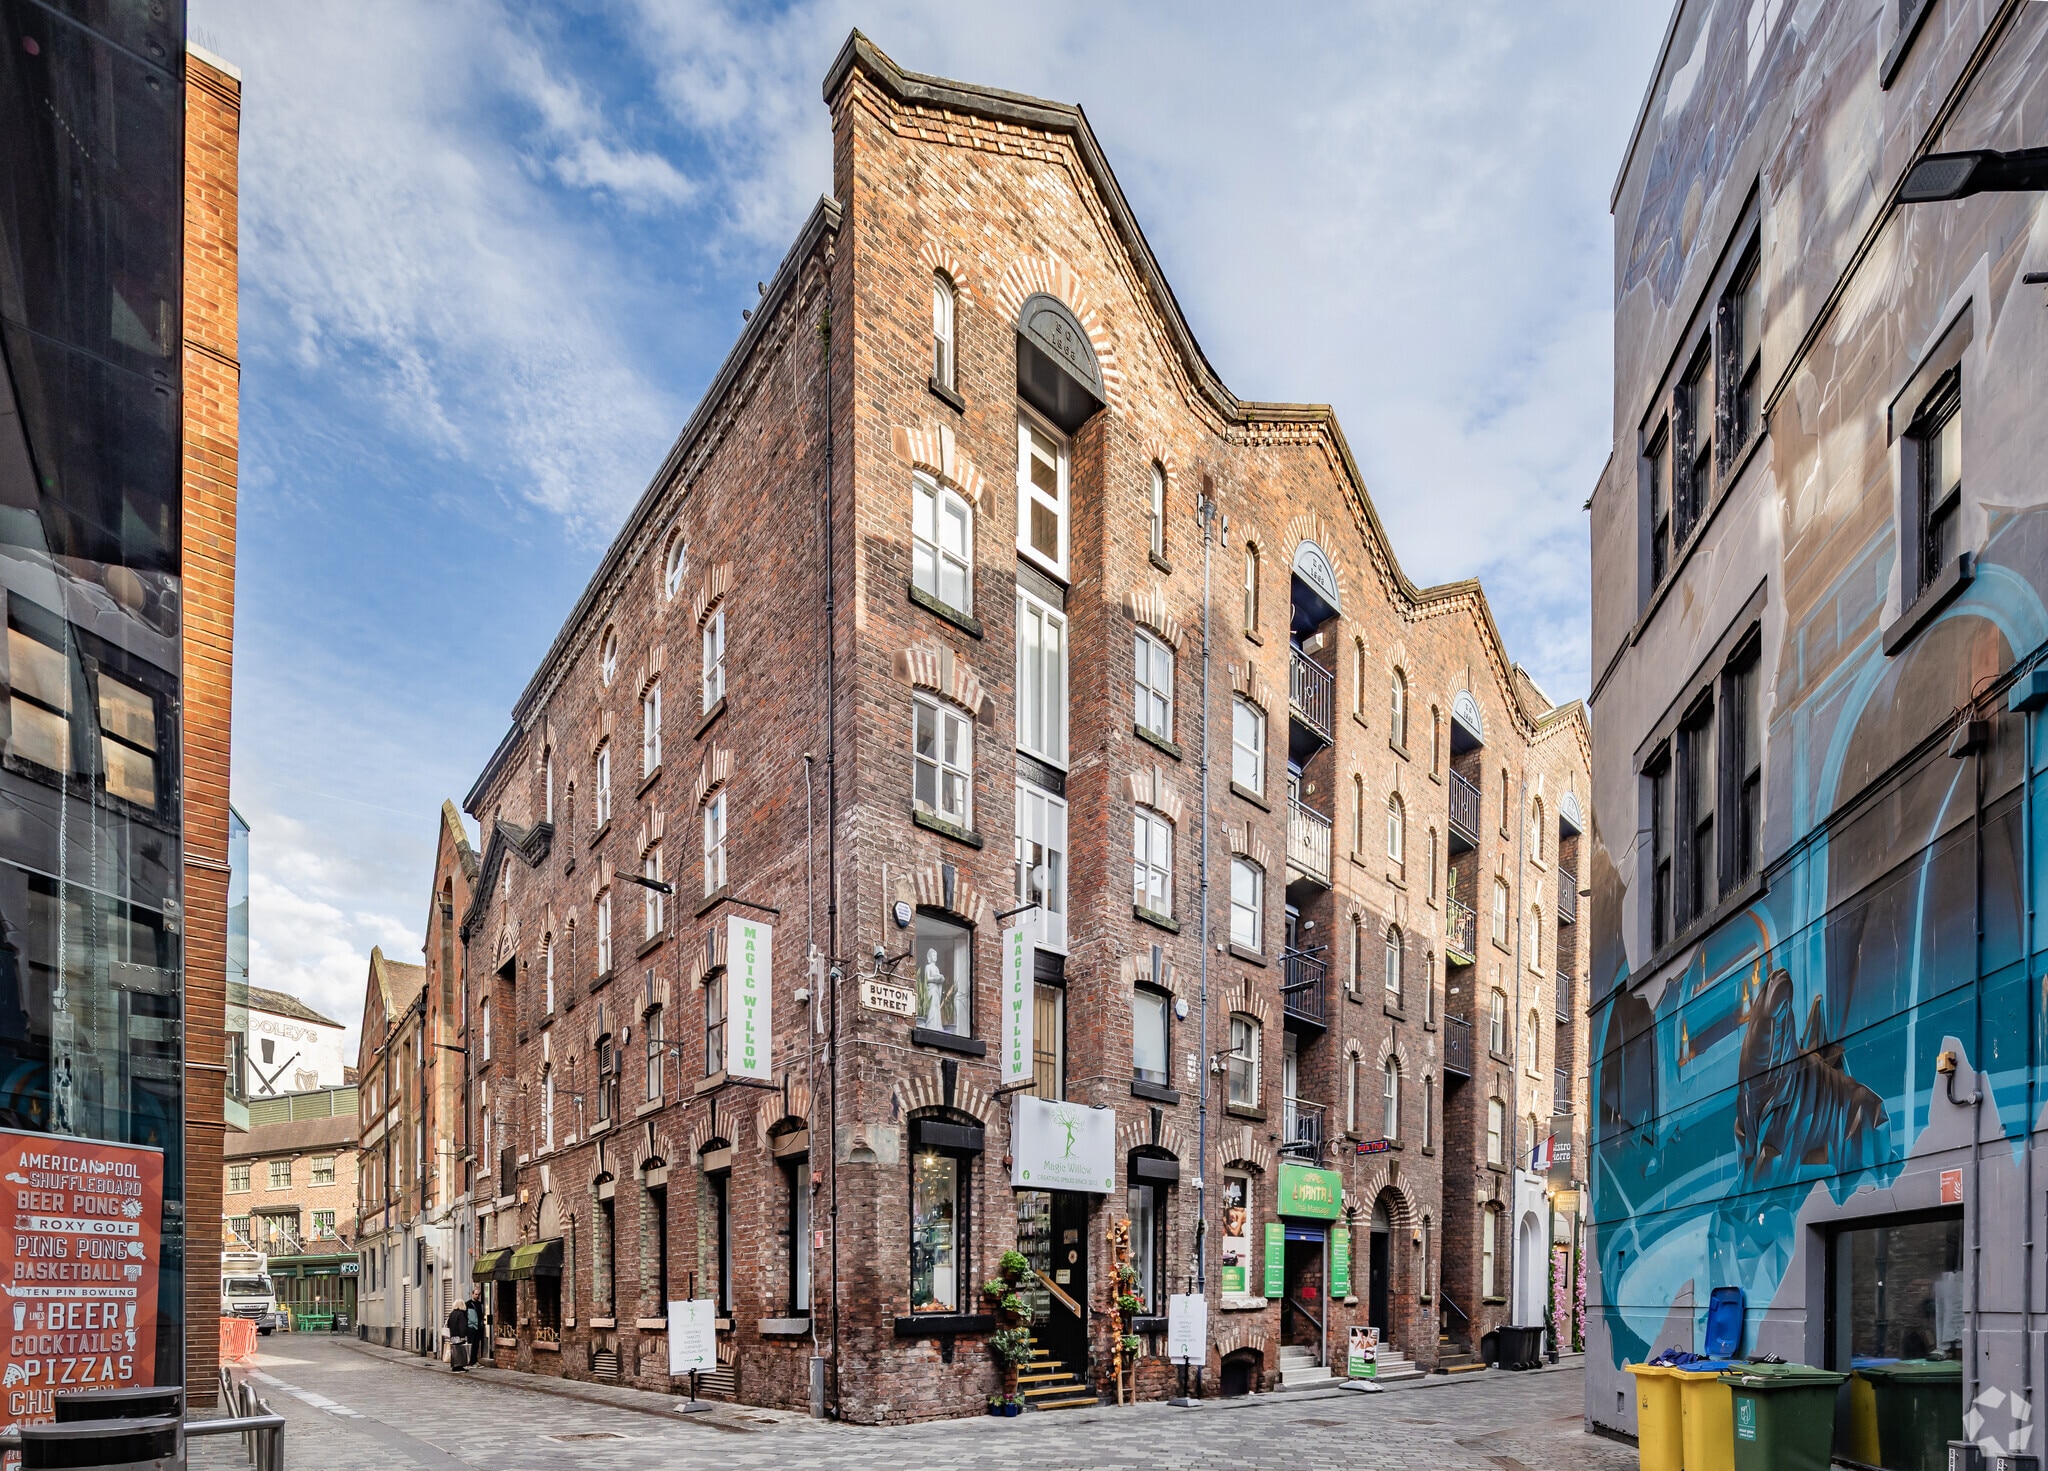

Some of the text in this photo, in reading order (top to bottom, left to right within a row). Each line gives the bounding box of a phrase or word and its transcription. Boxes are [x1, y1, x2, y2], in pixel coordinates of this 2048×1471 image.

[742, 926, 757, 1070] MAGIC WILLOW
[870, 984, 908, 1000] BUTTON
[870, 996, 907, 1012] STREET
[1012, 931, 1023, 1074] MAGIC WILLOW
[20, 1152, 140, 1178] AMERICAN POOL
[1044, 1160, 1092, 1174] Magic Willow
[1553, 1152, 1570, 1160] ierre
[30, 1172, 142, 1196] SHUFFLEBOARD
[18, 1190, 119, 1216] BEER PONG
[40, 1220, 134, 1233] ROXY GOLF
[14, 1235, 128, 1260] PING PONG
[14, 1262, 120, 1282] BASKETBALL
[30, 1311, 45, 1321] LINES
[48, 1302, 118, 1330] BEER
[11, 1332, 122, 1356] COCKTAILS
[24, 1356, 134, 1386] PIZZAS
